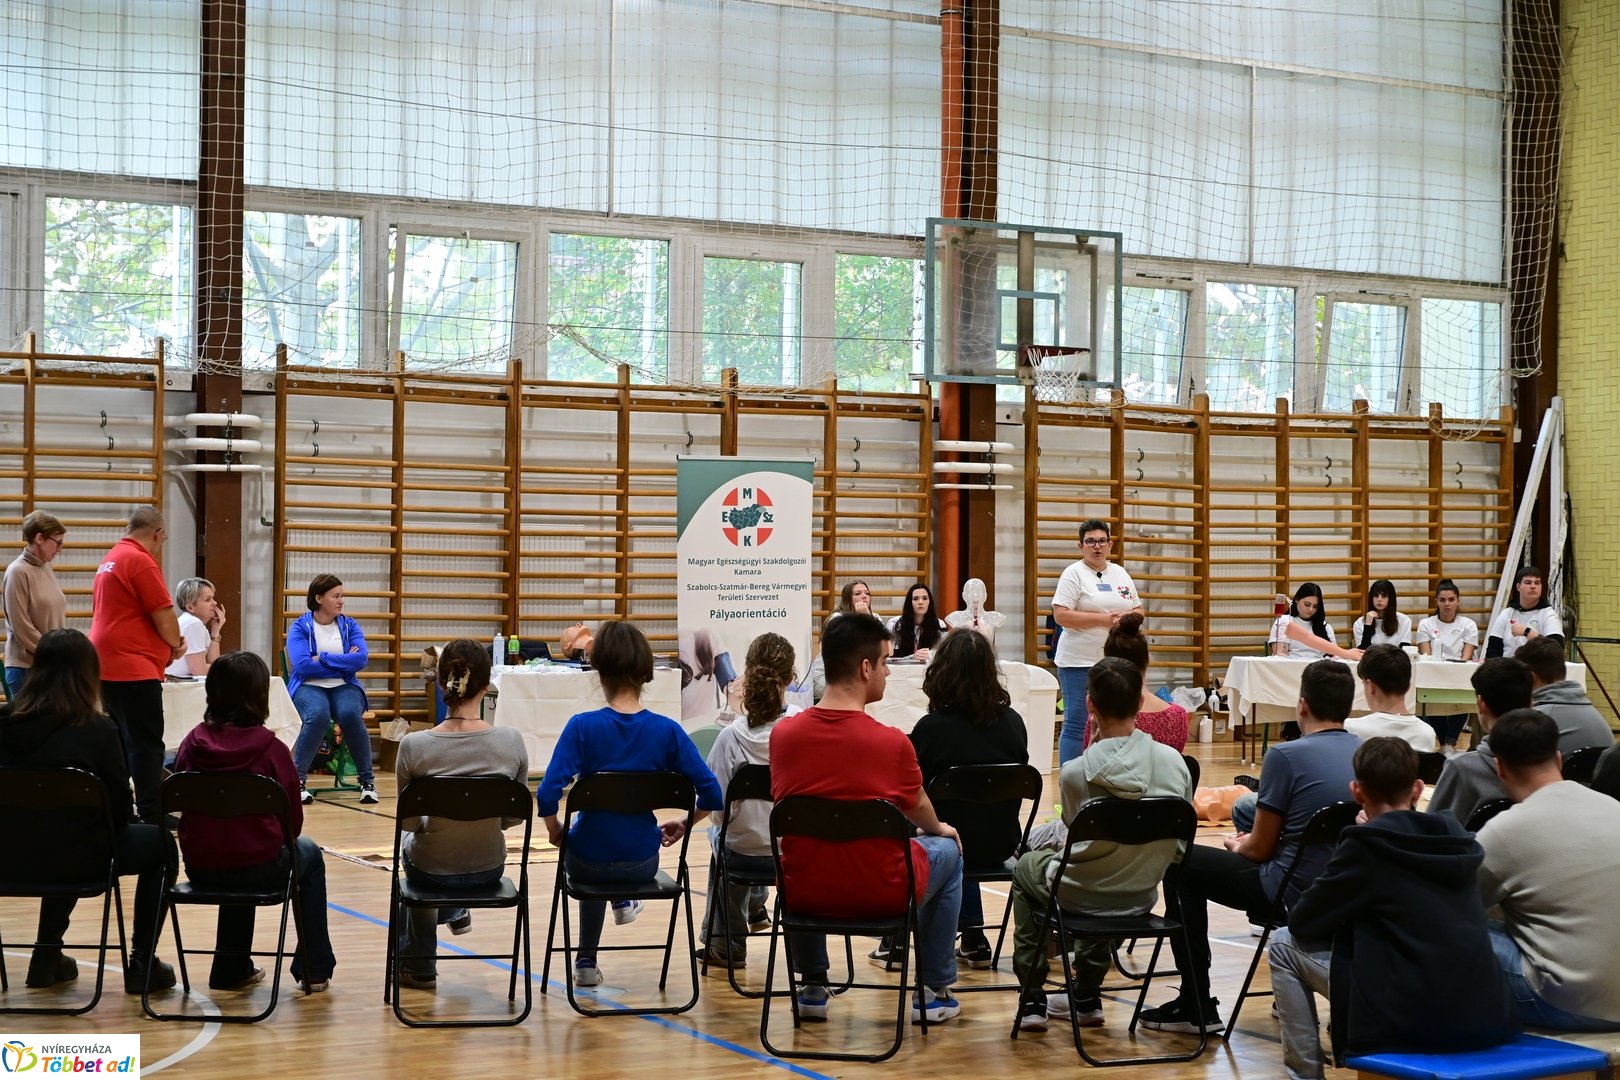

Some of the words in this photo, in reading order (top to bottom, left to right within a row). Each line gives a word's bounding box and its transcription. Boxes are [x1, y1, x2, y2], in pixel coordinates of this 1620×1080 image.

[743, 488, 752, 499] M
[722, 512, 728, 522] E
[744, 536, 752, 546] K
[717, 558, 760, 566] Egészségügyi
[763, 558, 806, 566] Szakdolgozói
[687, 583, 770, 591] Szabolcs-Szatmár-Bereg
[772, 582, 808, 591] Vármegyei
[710, 608, 786, 621] Pályaorientáció
